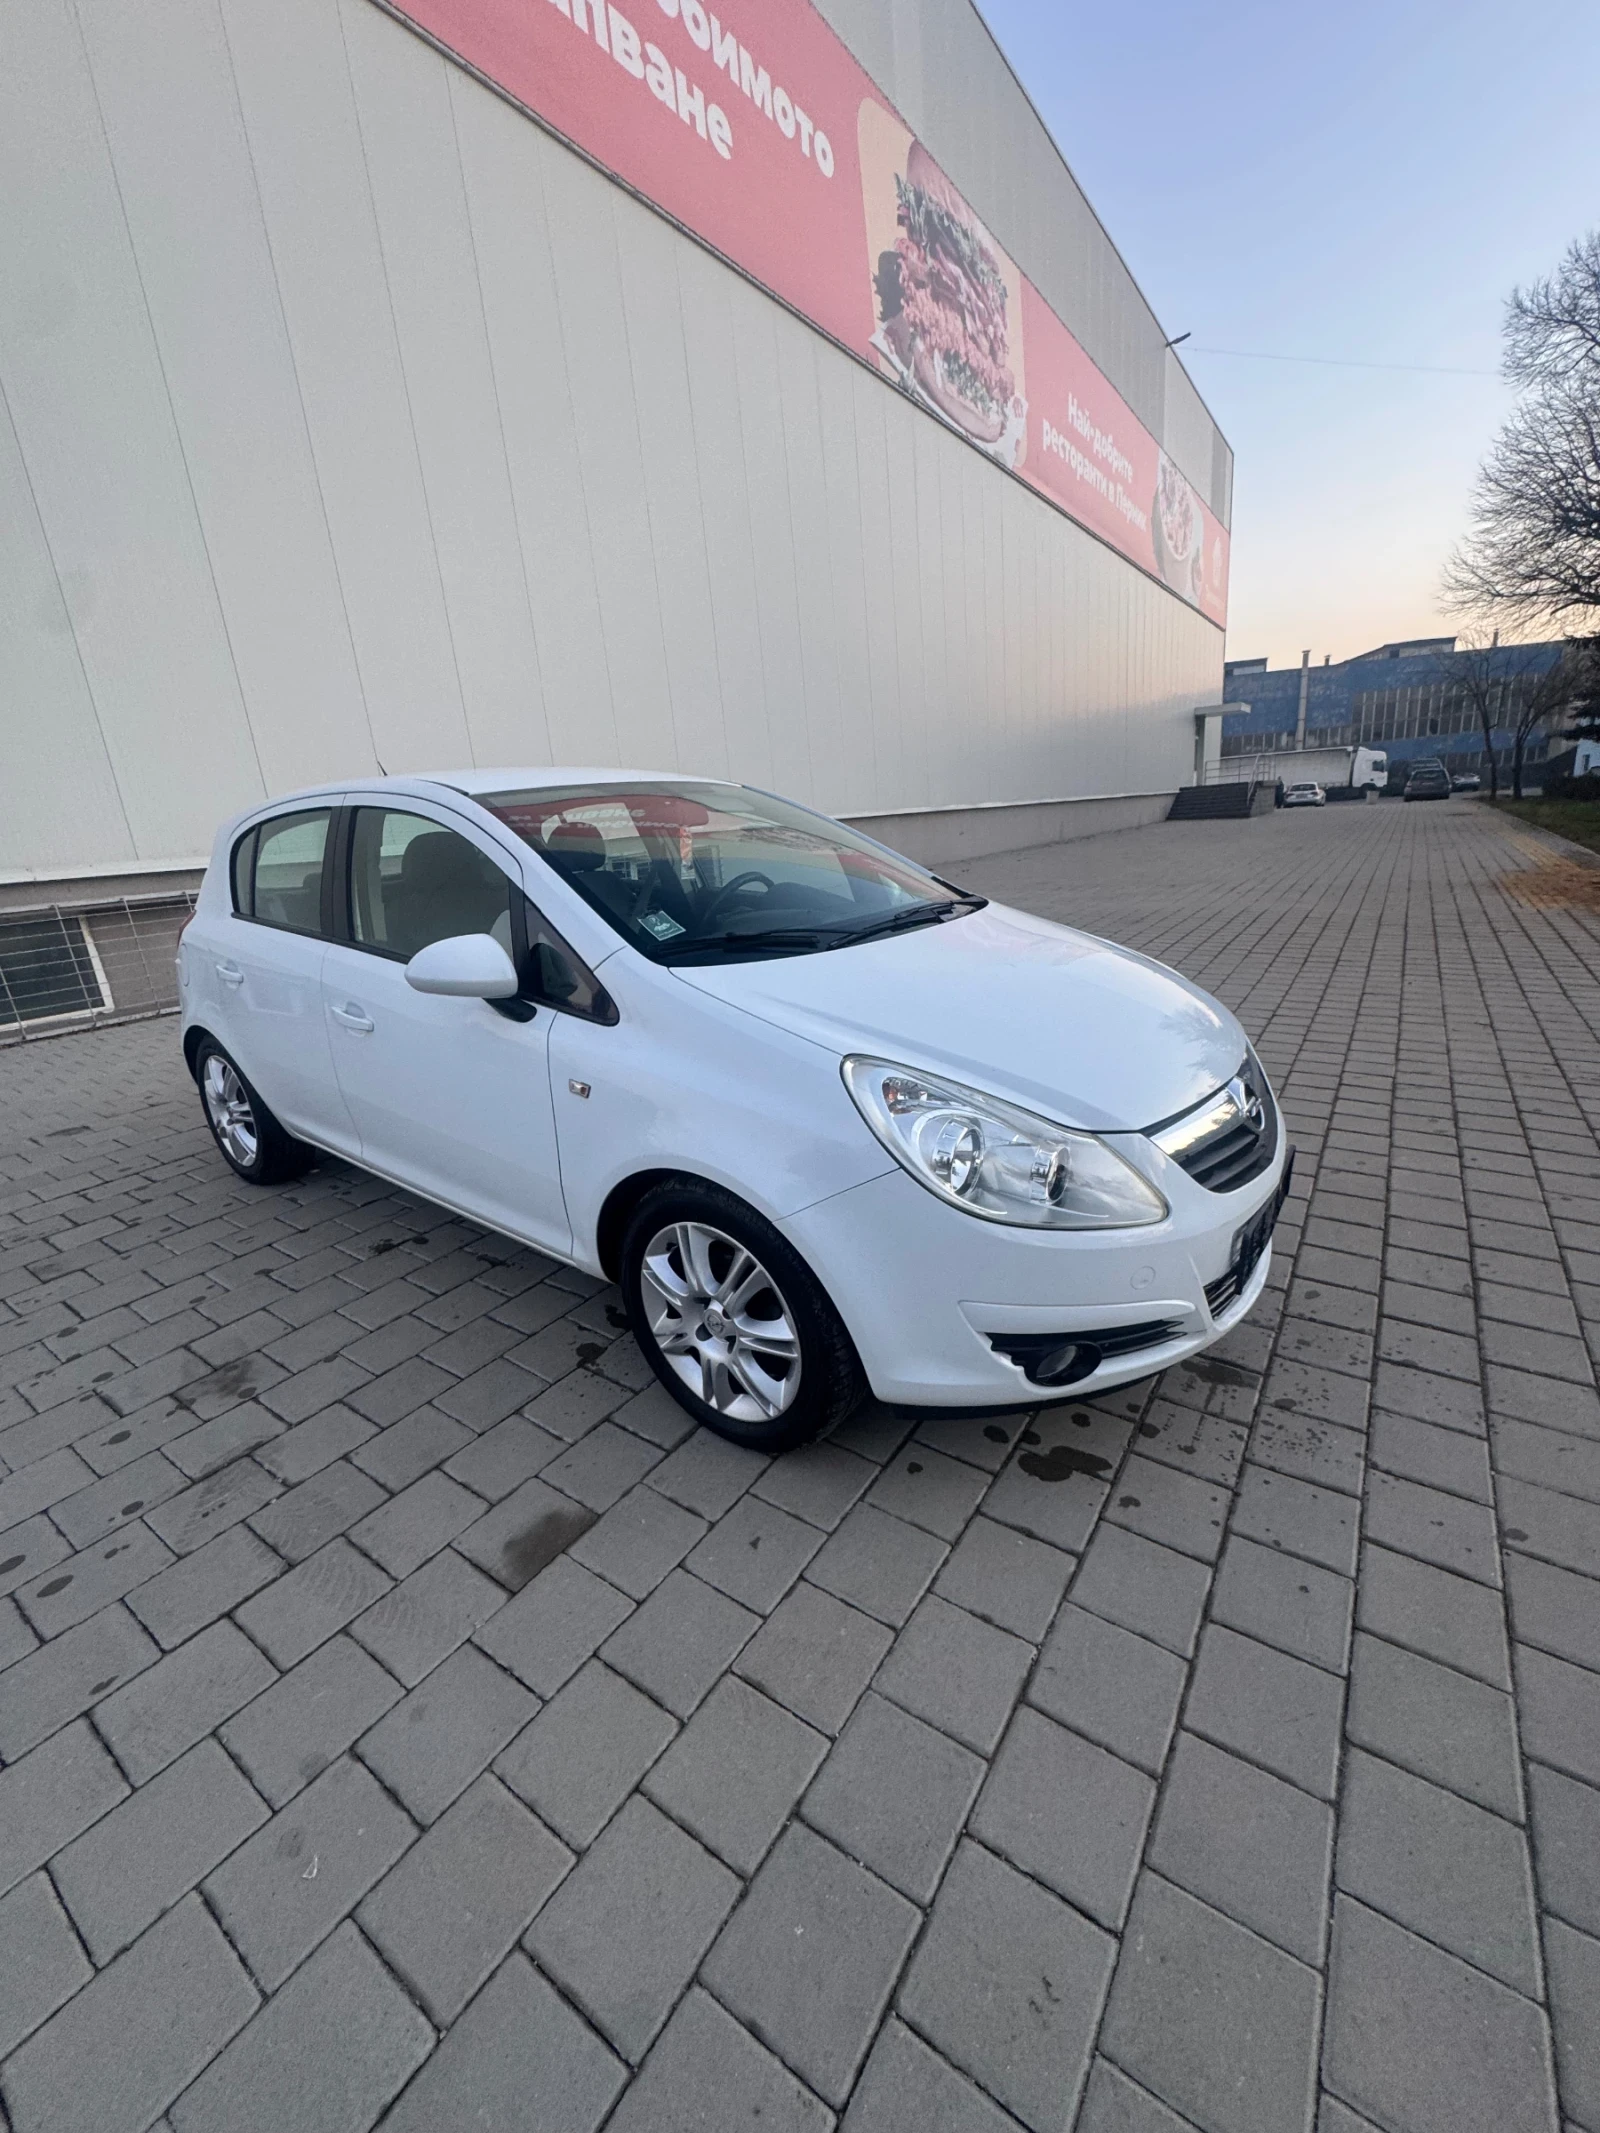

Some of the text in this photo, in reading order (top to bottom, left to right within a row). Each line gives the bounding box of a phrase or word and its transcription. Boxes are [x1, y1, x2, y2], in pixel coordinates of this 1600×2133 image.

[547, 0, 733, 160] пване
[1042, 418, 1107, 497] ресторанти
[1067, 391, 1133, 484] Най-добрите
